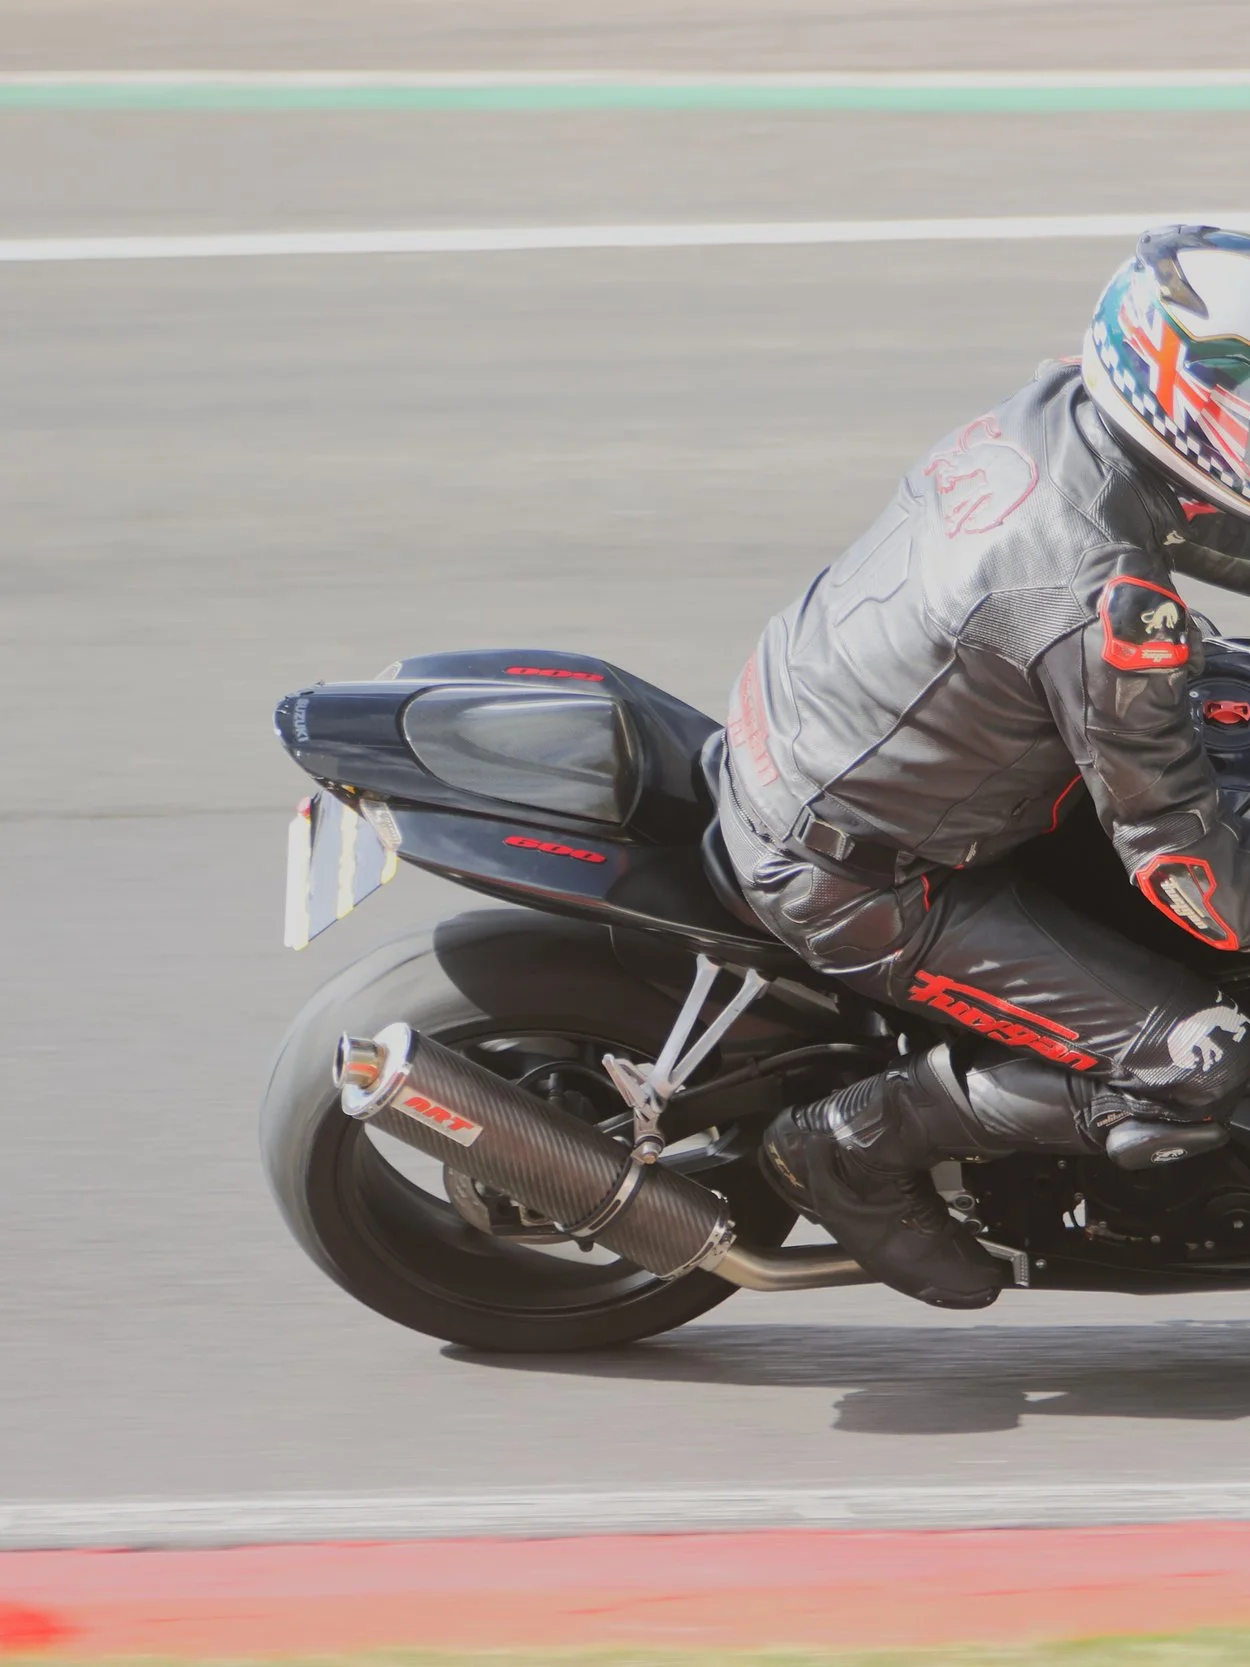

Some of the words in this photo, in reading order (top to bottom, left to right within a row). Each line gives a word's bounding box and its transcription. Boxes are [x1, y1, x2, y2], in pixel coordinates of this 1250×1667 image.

[294, 699, 310, 742] SUZUKI
[503, 835, 607, 864] 600
[403, 1096, 474, 1131] ART
